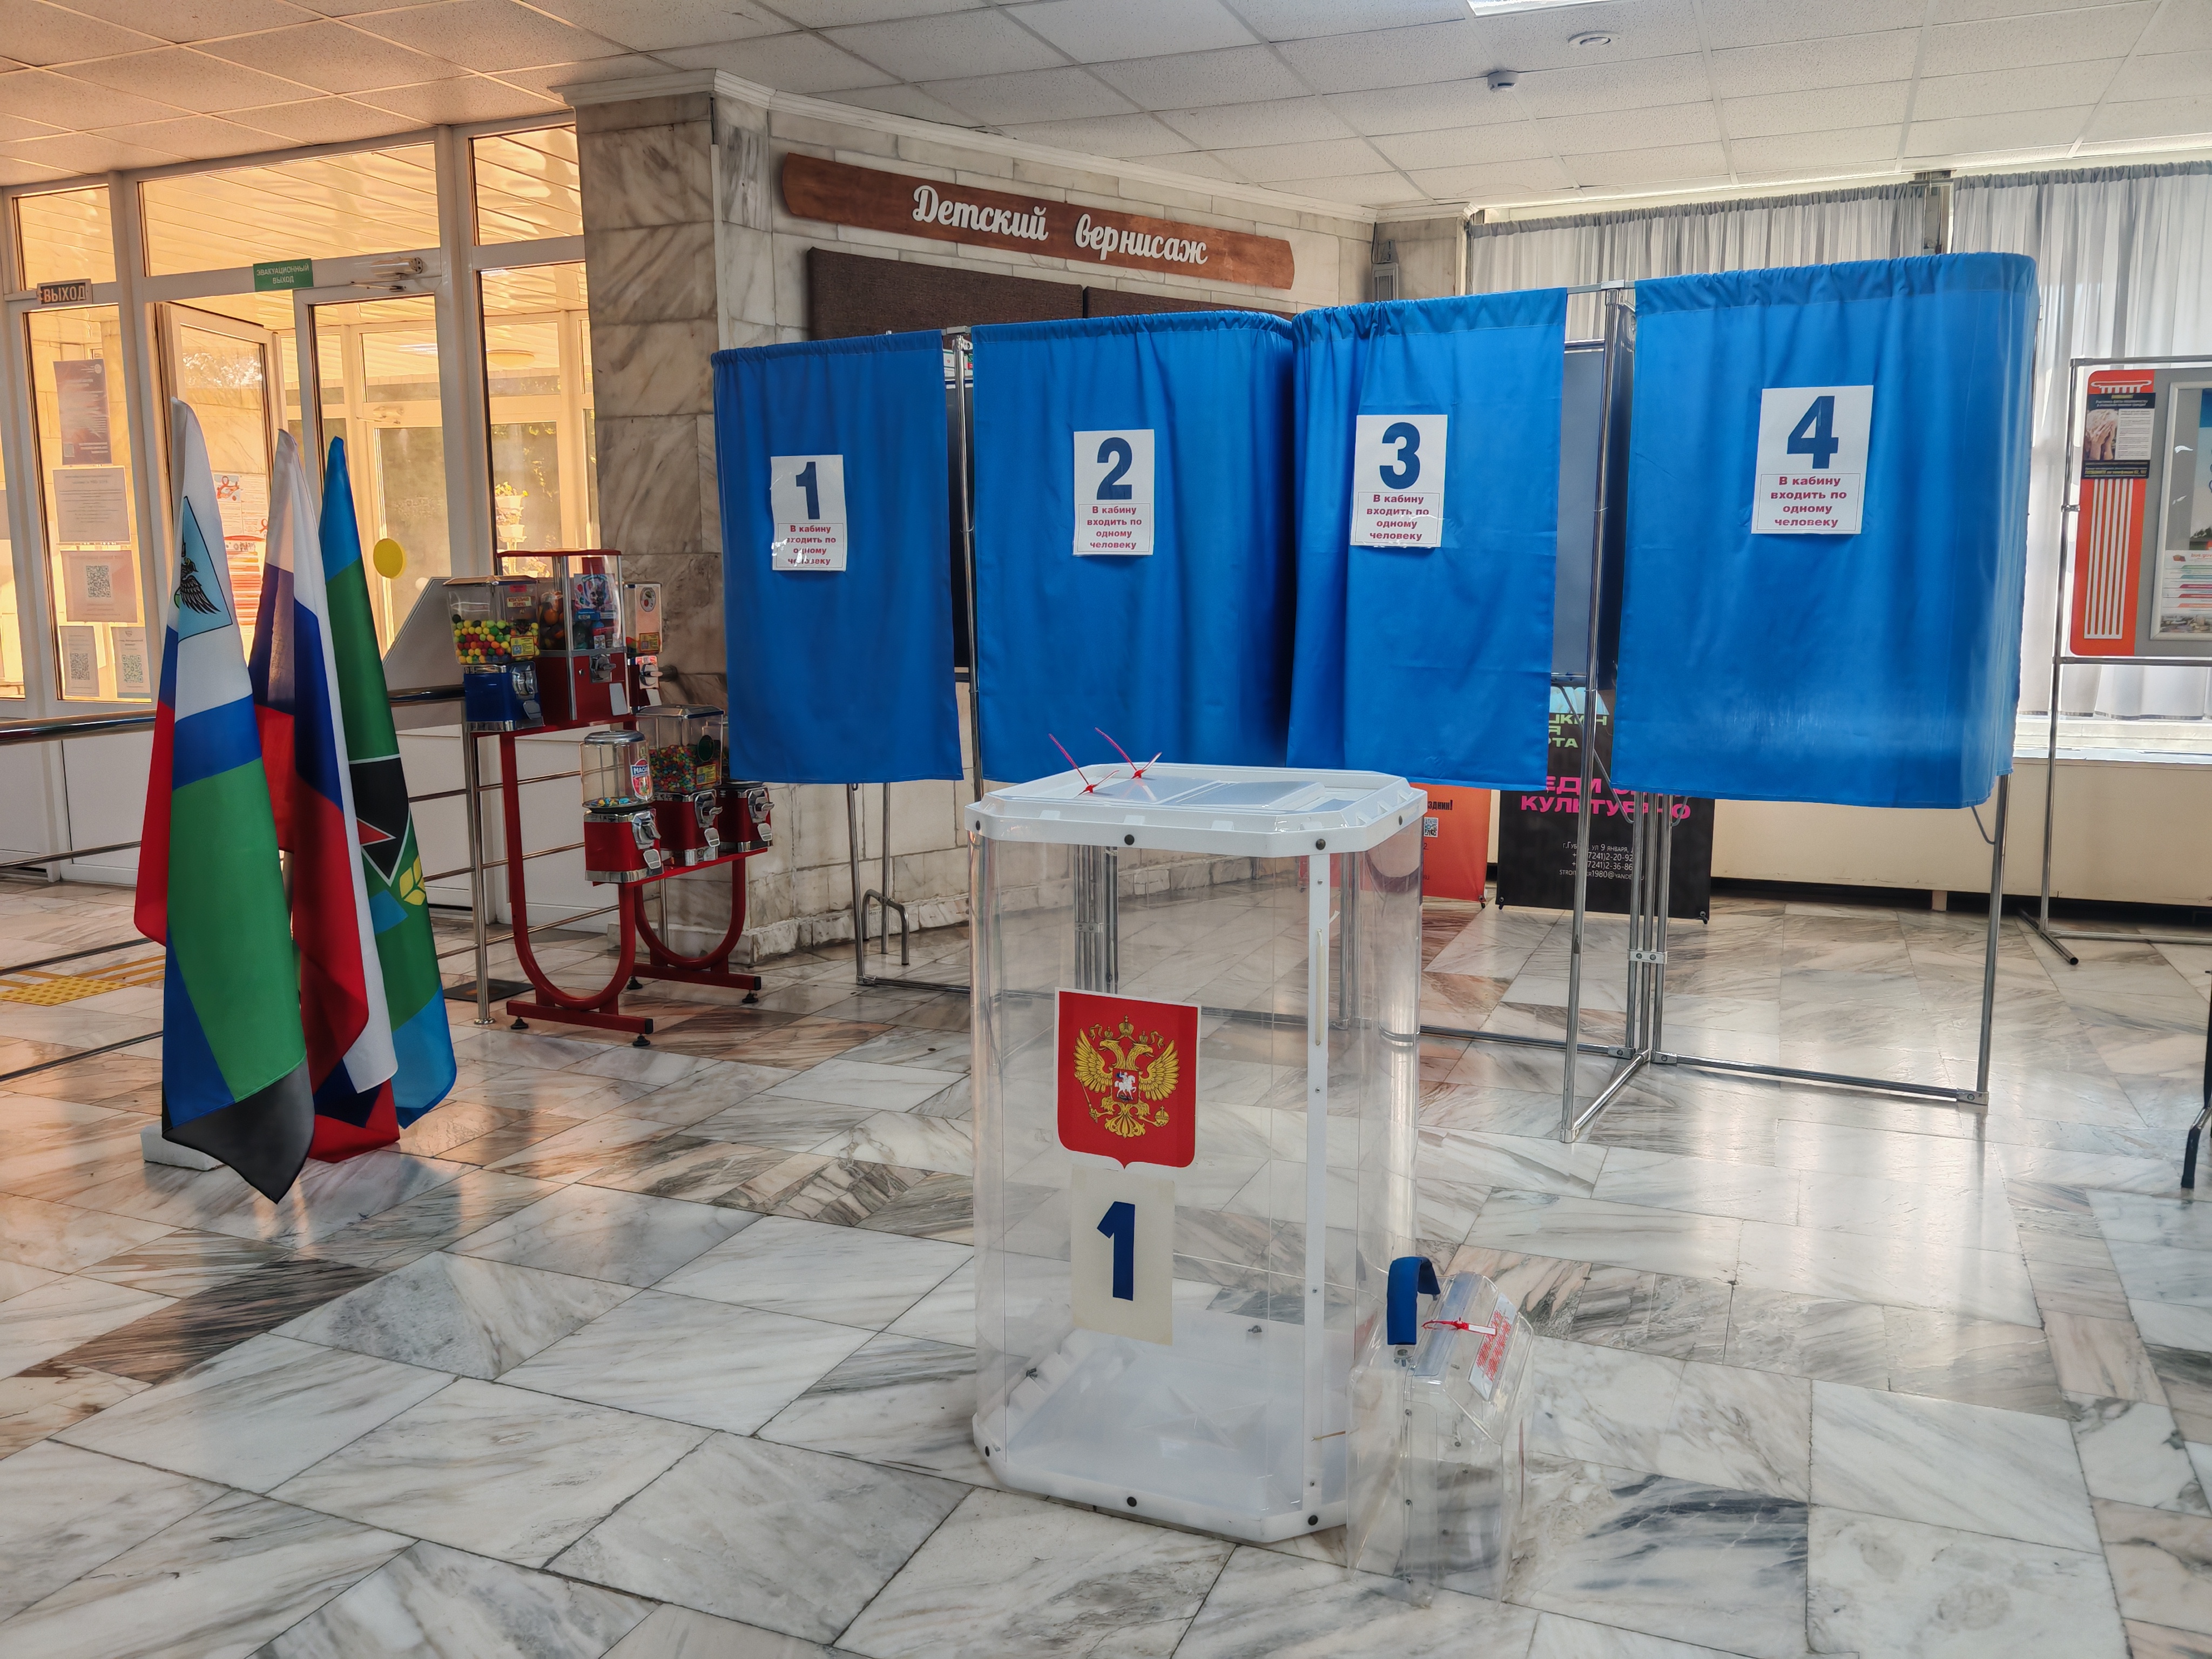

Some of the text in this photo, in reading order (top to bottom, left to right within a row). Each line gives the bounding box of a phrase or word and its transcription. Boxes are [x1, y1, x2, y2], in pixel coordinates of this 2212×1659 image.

[912, 185, 1209, 265] Детский вернисаж
[257, 263, 309, 276] ЭВАКУАЦИОННЫЙ
[272, 275, 294, 284] ВЫХОД
[44, 285, 86, 302] ВЫХОД
[1787, 395, 1839, 469] 4
[1379, 422, 1421, 489] 3
[1096, 437, 1132, 500] 2
[1779, 476, 1841, 487] В кабину
[795, 461, 820, 520] 1
[1771, 491, 1826, 500] входить
[1373, 494, 1424, 504] В кабину
[1102, 506, 1136, 515] кабину
[1366, 508, 1412, 516] входить
[1783, 505, 1832, 514] одному
[1087, 518, 1127, 527] входить
[1377, 520, 1418, 529] одному
[1775, 518, 1838, 528] человеку
[799, 525, 831, 534] кабину
[1370, 532, 1422, 541] человеку
[1090, 542, 1137, 550] человеку
[1097, 1201, 1136, 1301] 1
